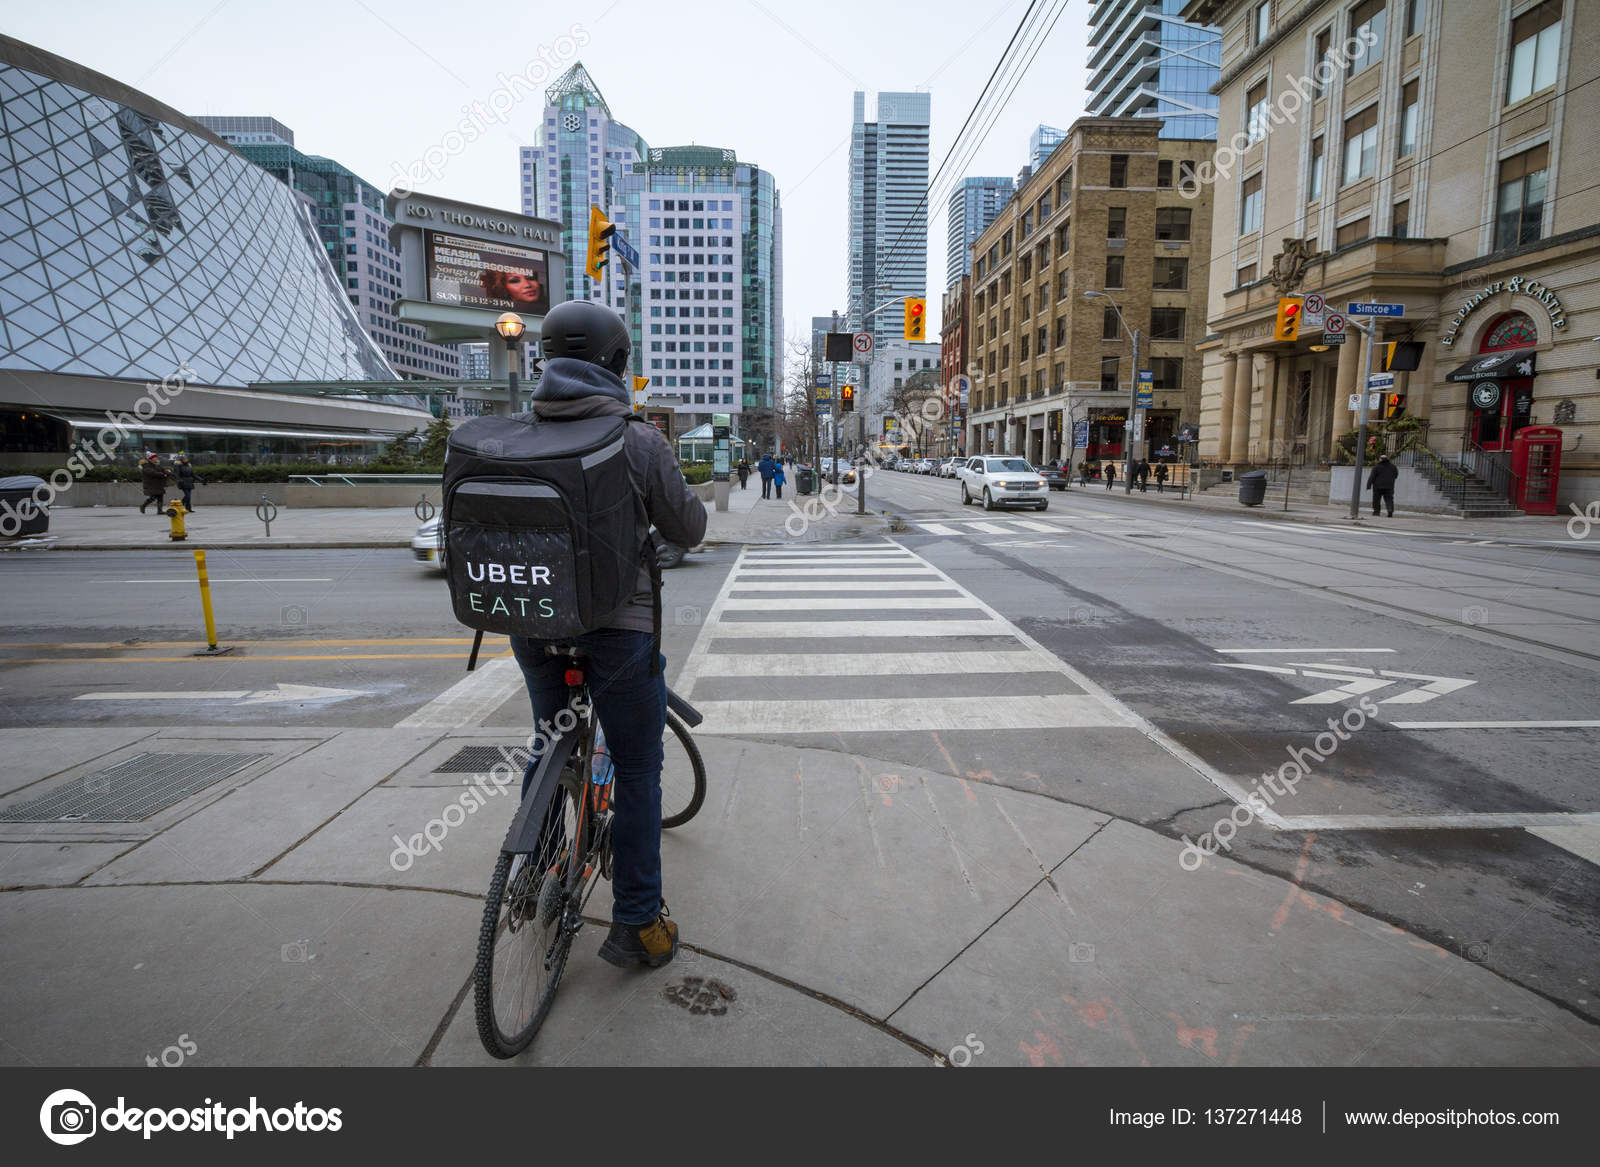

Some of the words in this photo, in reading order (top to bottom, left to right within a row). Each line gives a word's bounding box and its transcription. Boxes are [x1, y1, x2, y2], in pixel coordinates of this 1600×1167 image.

[407, 203, 437, 219] ROY
[441, 209, 519, 235] THOMSON
[523, 226, 555, 243] HALL
[434, 246, 480, 261] MEASHA
[435, 264, 468, 277] Songs
[470, 269, 481, 279] of
[436, 291, 457, 301] SUN
[1356, 303, 1390, 314] Simcoe
[1442, 280, 1503, 346] ELEPHANT
[1508, 276, 1524, 293] &
[1525, 280, 1566, 330] CASTLE
[466, 561, 551, 585] UBER
[469, 592, 554, 618] EATS
